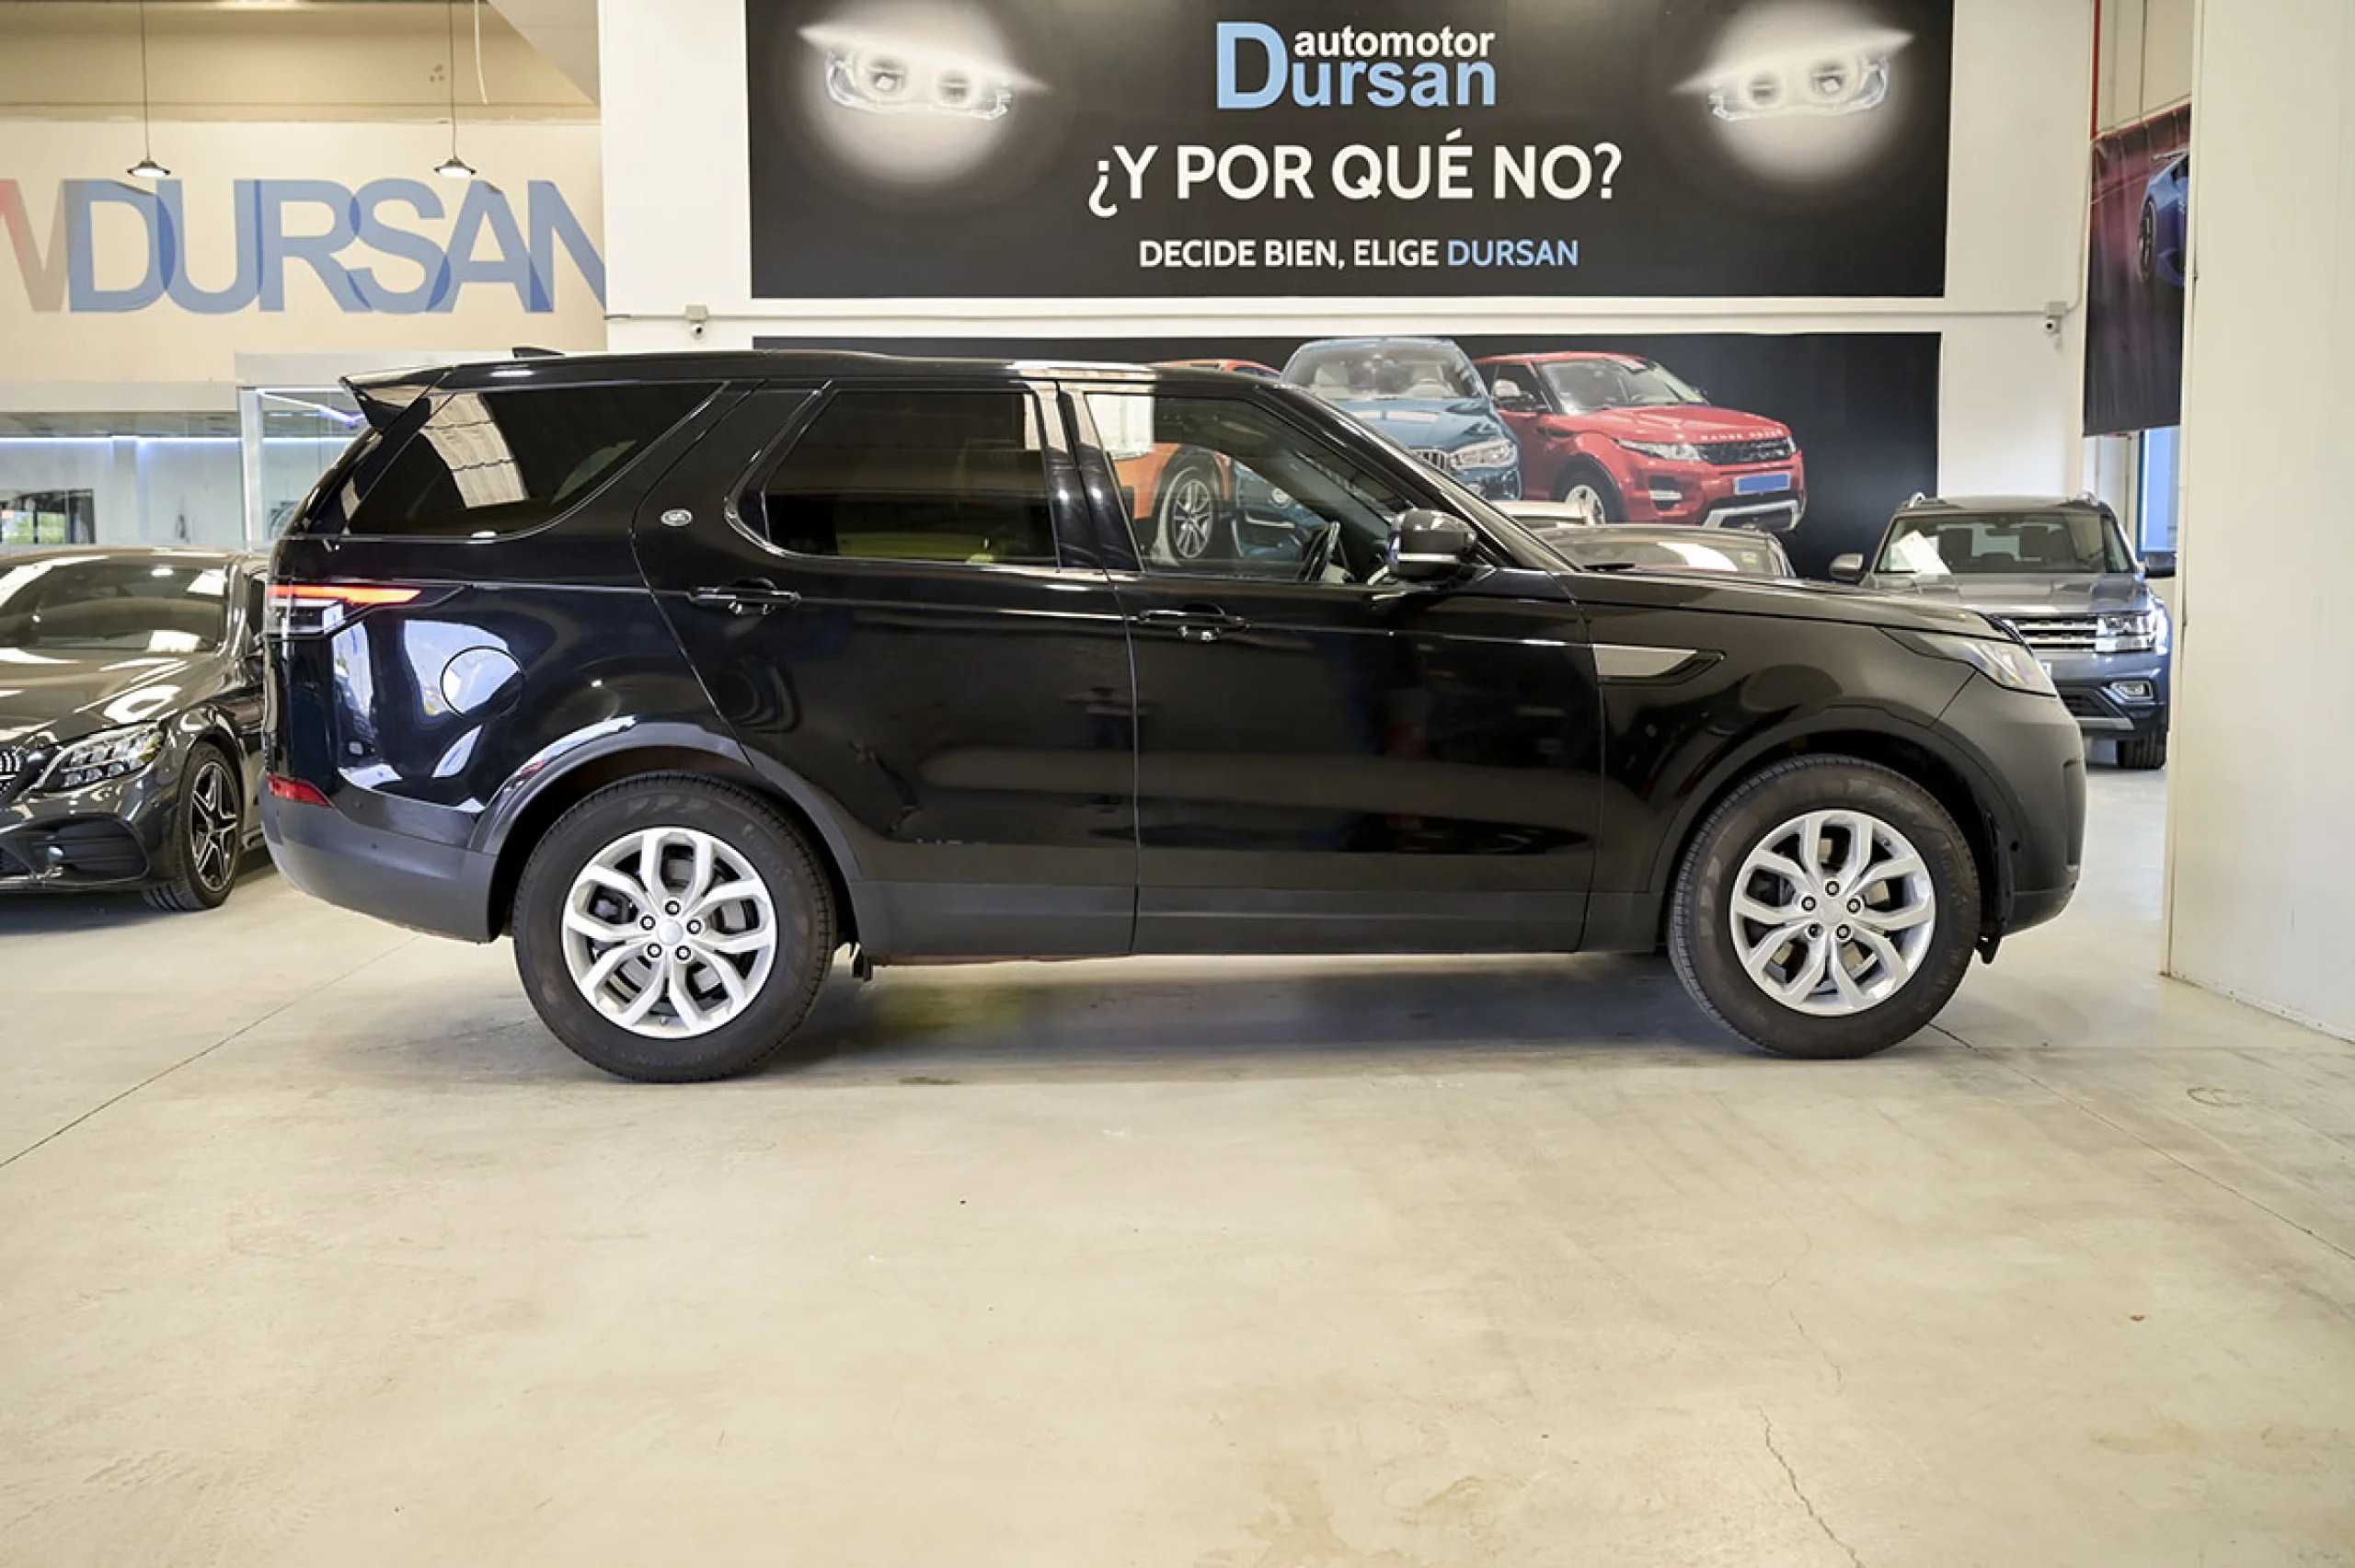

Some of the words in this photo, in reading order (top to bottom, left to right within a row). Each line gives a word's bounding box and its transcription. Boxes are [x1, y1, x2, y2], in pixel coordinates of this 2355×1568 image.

[1216, 21, 1497, 109] Dursan
[1294, 25, 1496, 57] automotor
[1088, 144, 1158, 217] ¿Y
[1177, 144, 1314, 200] POR
[1331, 129, 1473, 200] QUÉ
[1493, 143, 1622, 200] NO?
[1139, 240, 1257, 268] DECIDE
[1265, 240, 1345, 269] BIEN,
[1353, 239, 1439, 267] ELIGE
[1447, 239, 1579, 267] DURSAN
